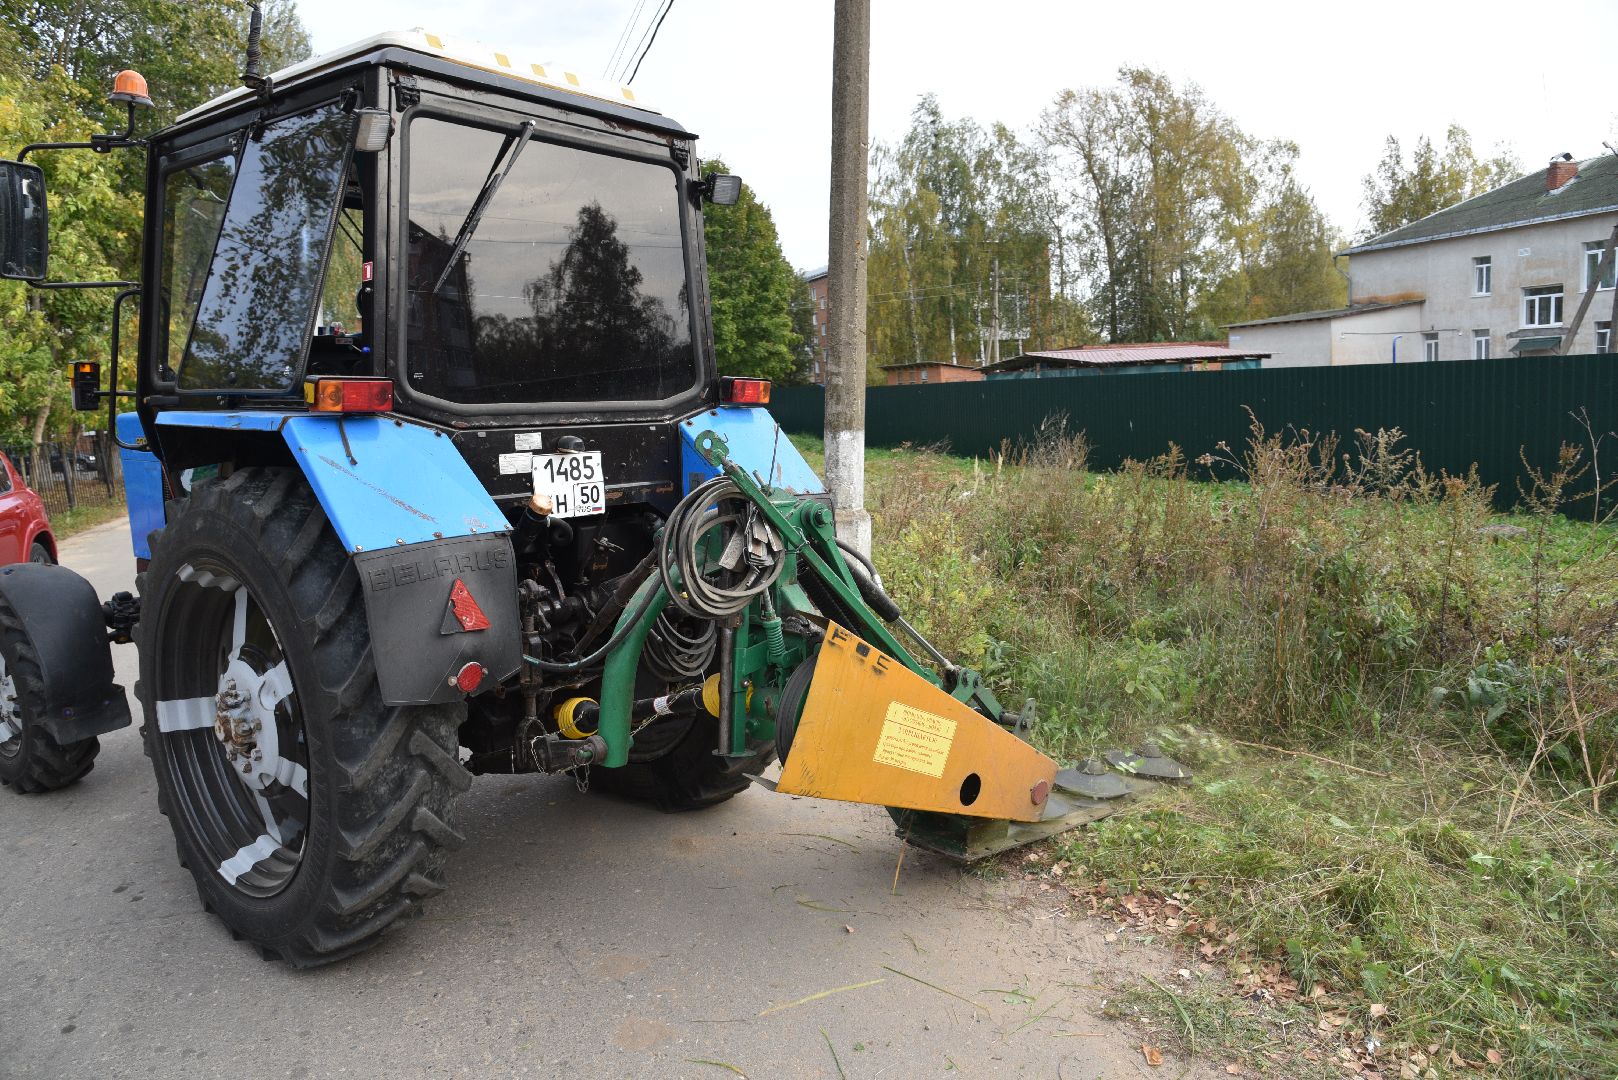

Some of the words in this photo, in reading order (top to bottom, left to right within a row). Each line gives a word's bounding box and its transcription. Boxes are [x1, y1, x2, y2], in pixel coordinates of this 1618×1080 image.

[543, 455, 595, 483] 1485
[580, 484, 600, 504] 50
[368, 549, 507, 592] BELARUS
